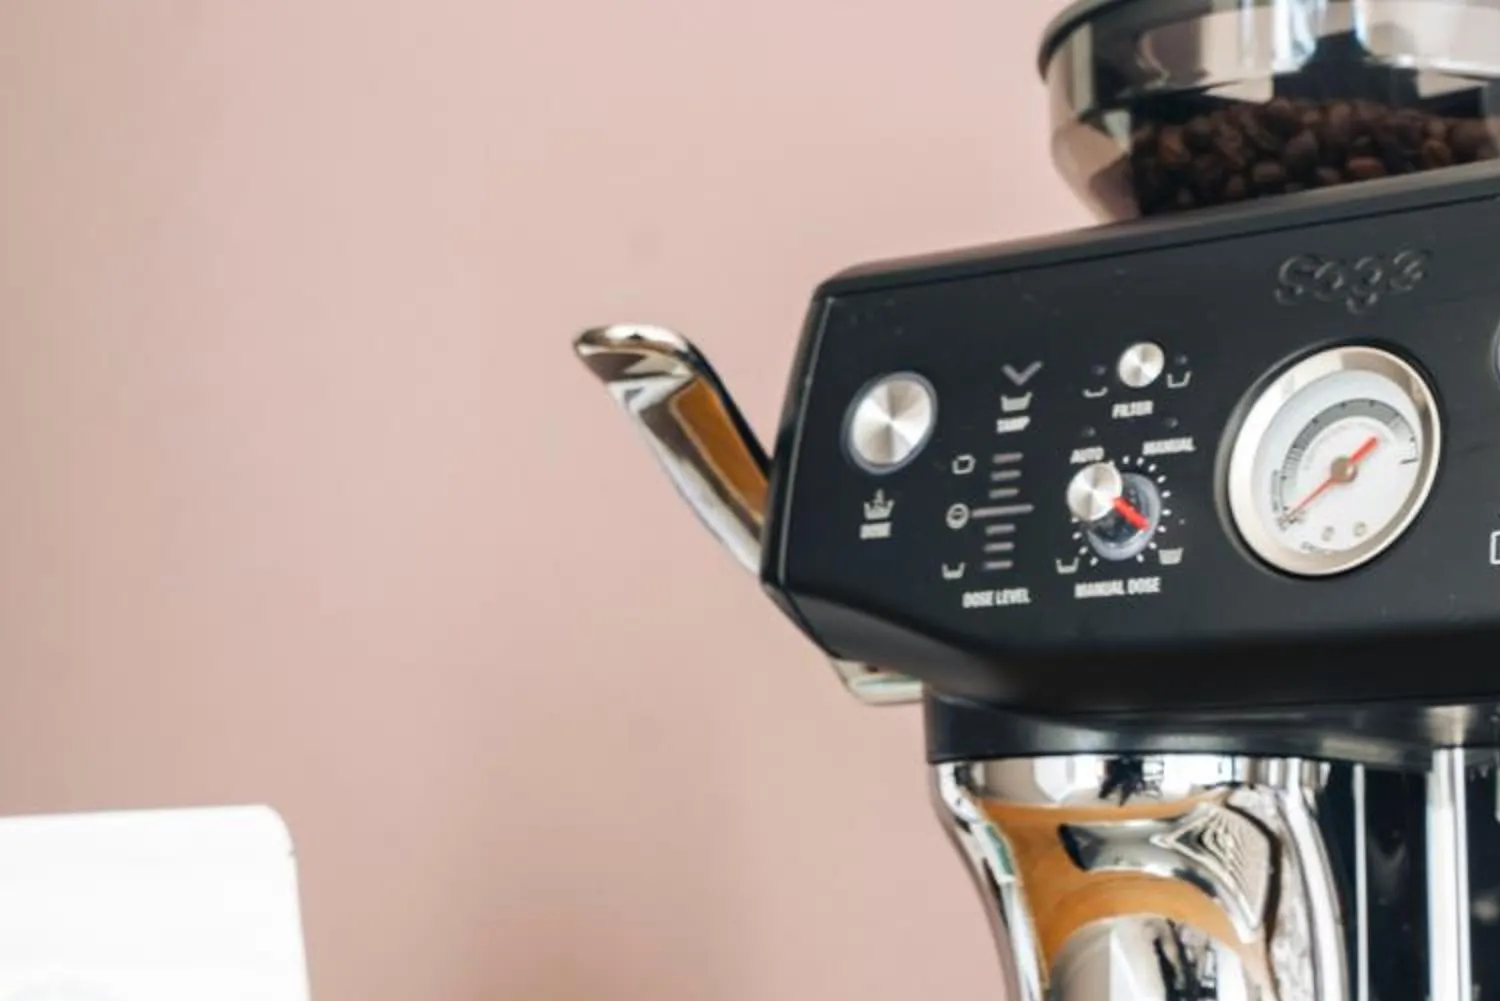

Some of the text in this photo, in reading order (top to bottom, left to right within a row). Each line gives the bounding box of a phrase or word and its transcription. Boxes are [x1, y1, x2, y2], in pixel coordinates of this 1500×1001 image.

[1111, 400, 1154, 419] FILTER
[1070, 446, 1105, 464] AUTO
[1142, 437, 1196, 456] MANUAL
[1074, 576, 1161, 598] MANUAL DOSE
[962, 587, 1031, 609] DOSE LEVEL
